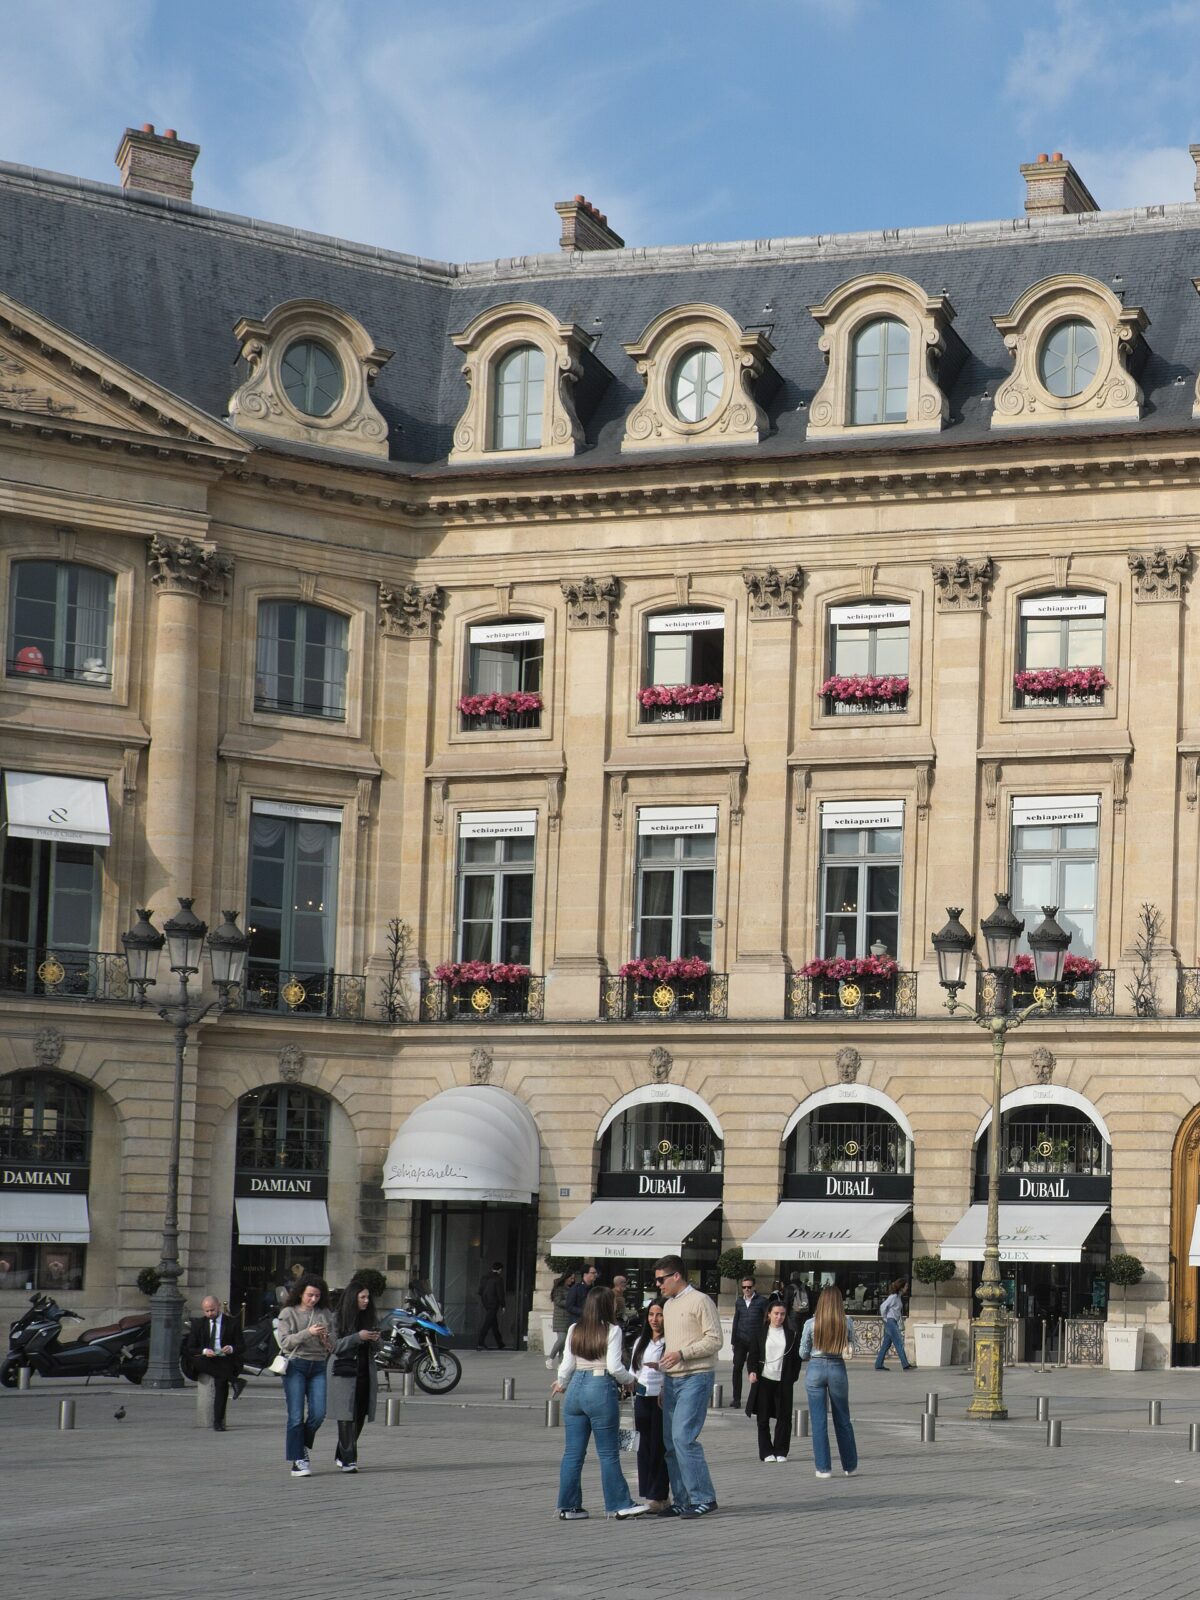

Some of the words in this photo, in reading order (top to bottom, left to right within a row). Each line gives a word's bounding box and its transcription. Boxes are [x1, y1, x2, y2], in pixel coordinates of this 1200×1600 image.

[1038, 605, 1087, 613] schiaparelli
[846, 613, 895, 621] schiaparelli
[664, 620, 711, 628] schiaparelli
[486, 631, 530, 639] schiaparelli
[1026, 812, 1084, 821] schiaparelli
[835, 817, 890, 826] schiaparelli
[472, 826, 523, 834] schiaparelli
[651, 823, 704, 832] schiaparelli
[3, 1170, 71, 1185] DAMIANI
[251, 1178, 312, 1193] DAMIANI
[638, 1175, 686, 1194] DUBAIL
[826, 1176, 874, 1196] DUBAIL
[1019, 1178, 1069, 1198] DUBAIL
[592, 1225, 656, 1237] DUBAIL
[787, 1228, 852, 1239] DUBAIL
[16, 1232, 61, 1242] DAMIANI
[265, 1235, 305, 1245] DAMIANI
[999, 1251, 1029, 1260] OLEX
